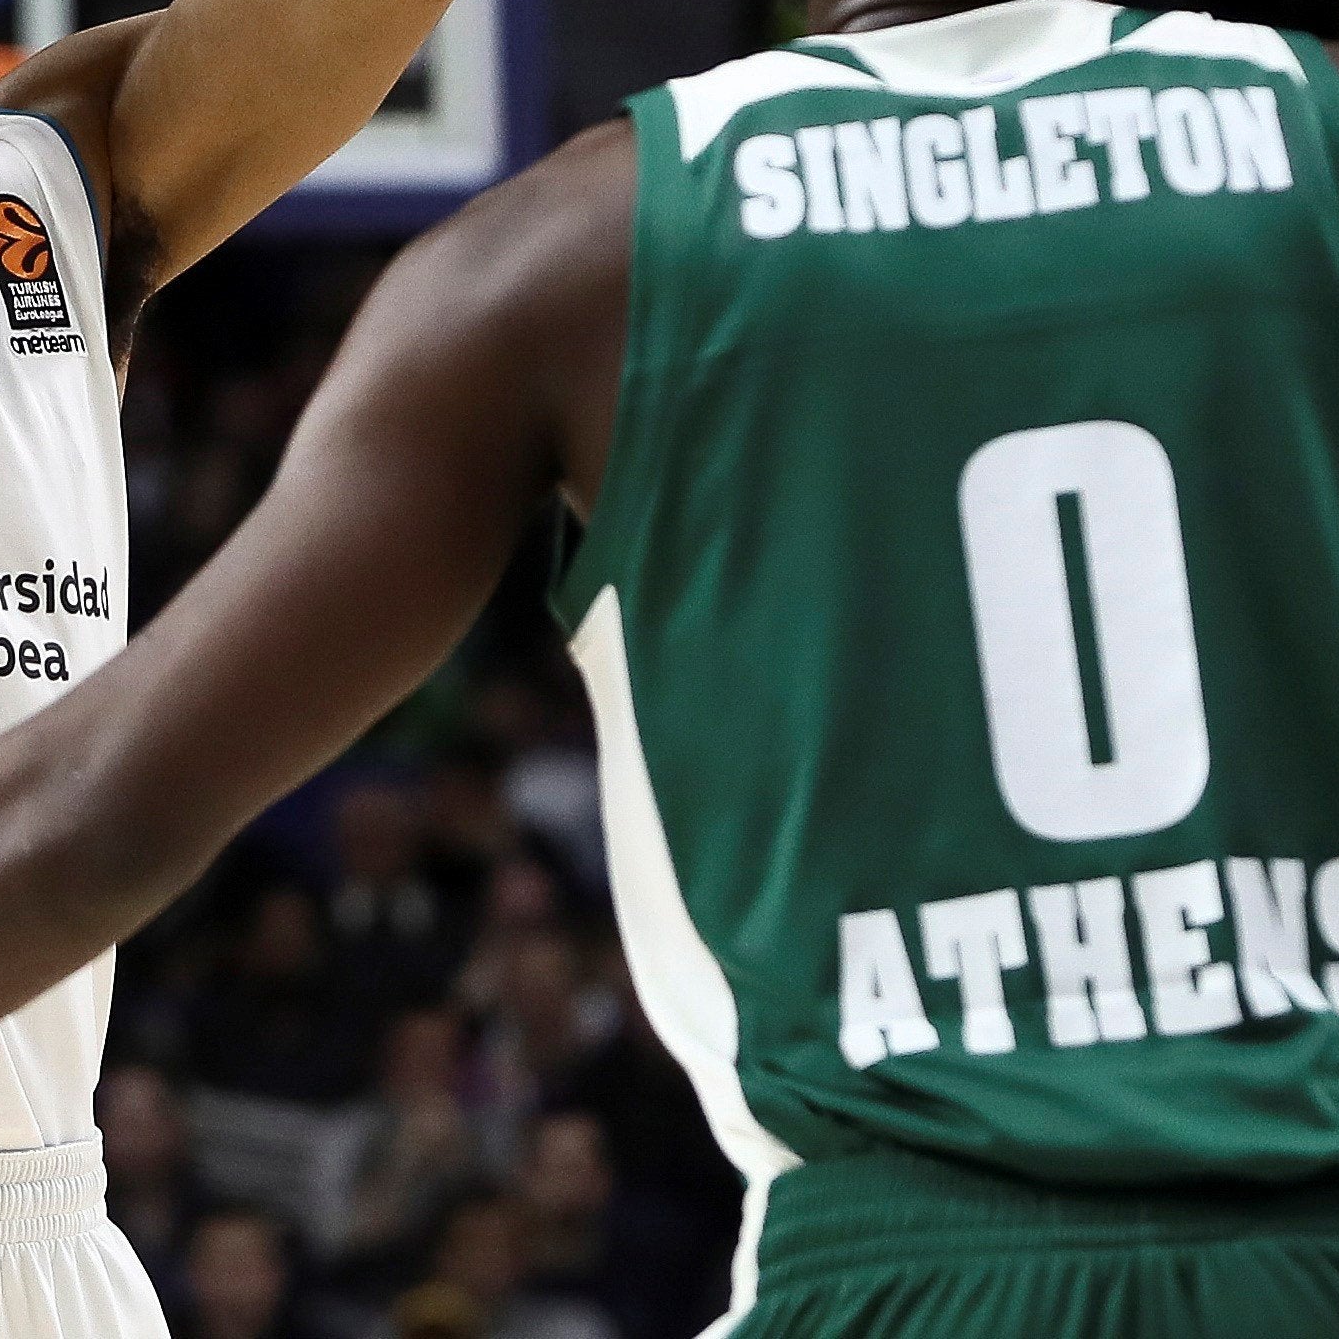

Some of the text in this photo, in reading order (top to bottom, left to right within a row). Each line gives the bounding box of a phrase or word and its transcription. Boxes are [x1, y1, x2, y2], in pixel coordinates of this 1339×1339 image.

[733, 85, 1294, 240] SINGLETON
[7, 280, 58, 296] TURKISH
[13, 294, 61, 309] AIRLINES
[957, 419, 1211, 843] 0
